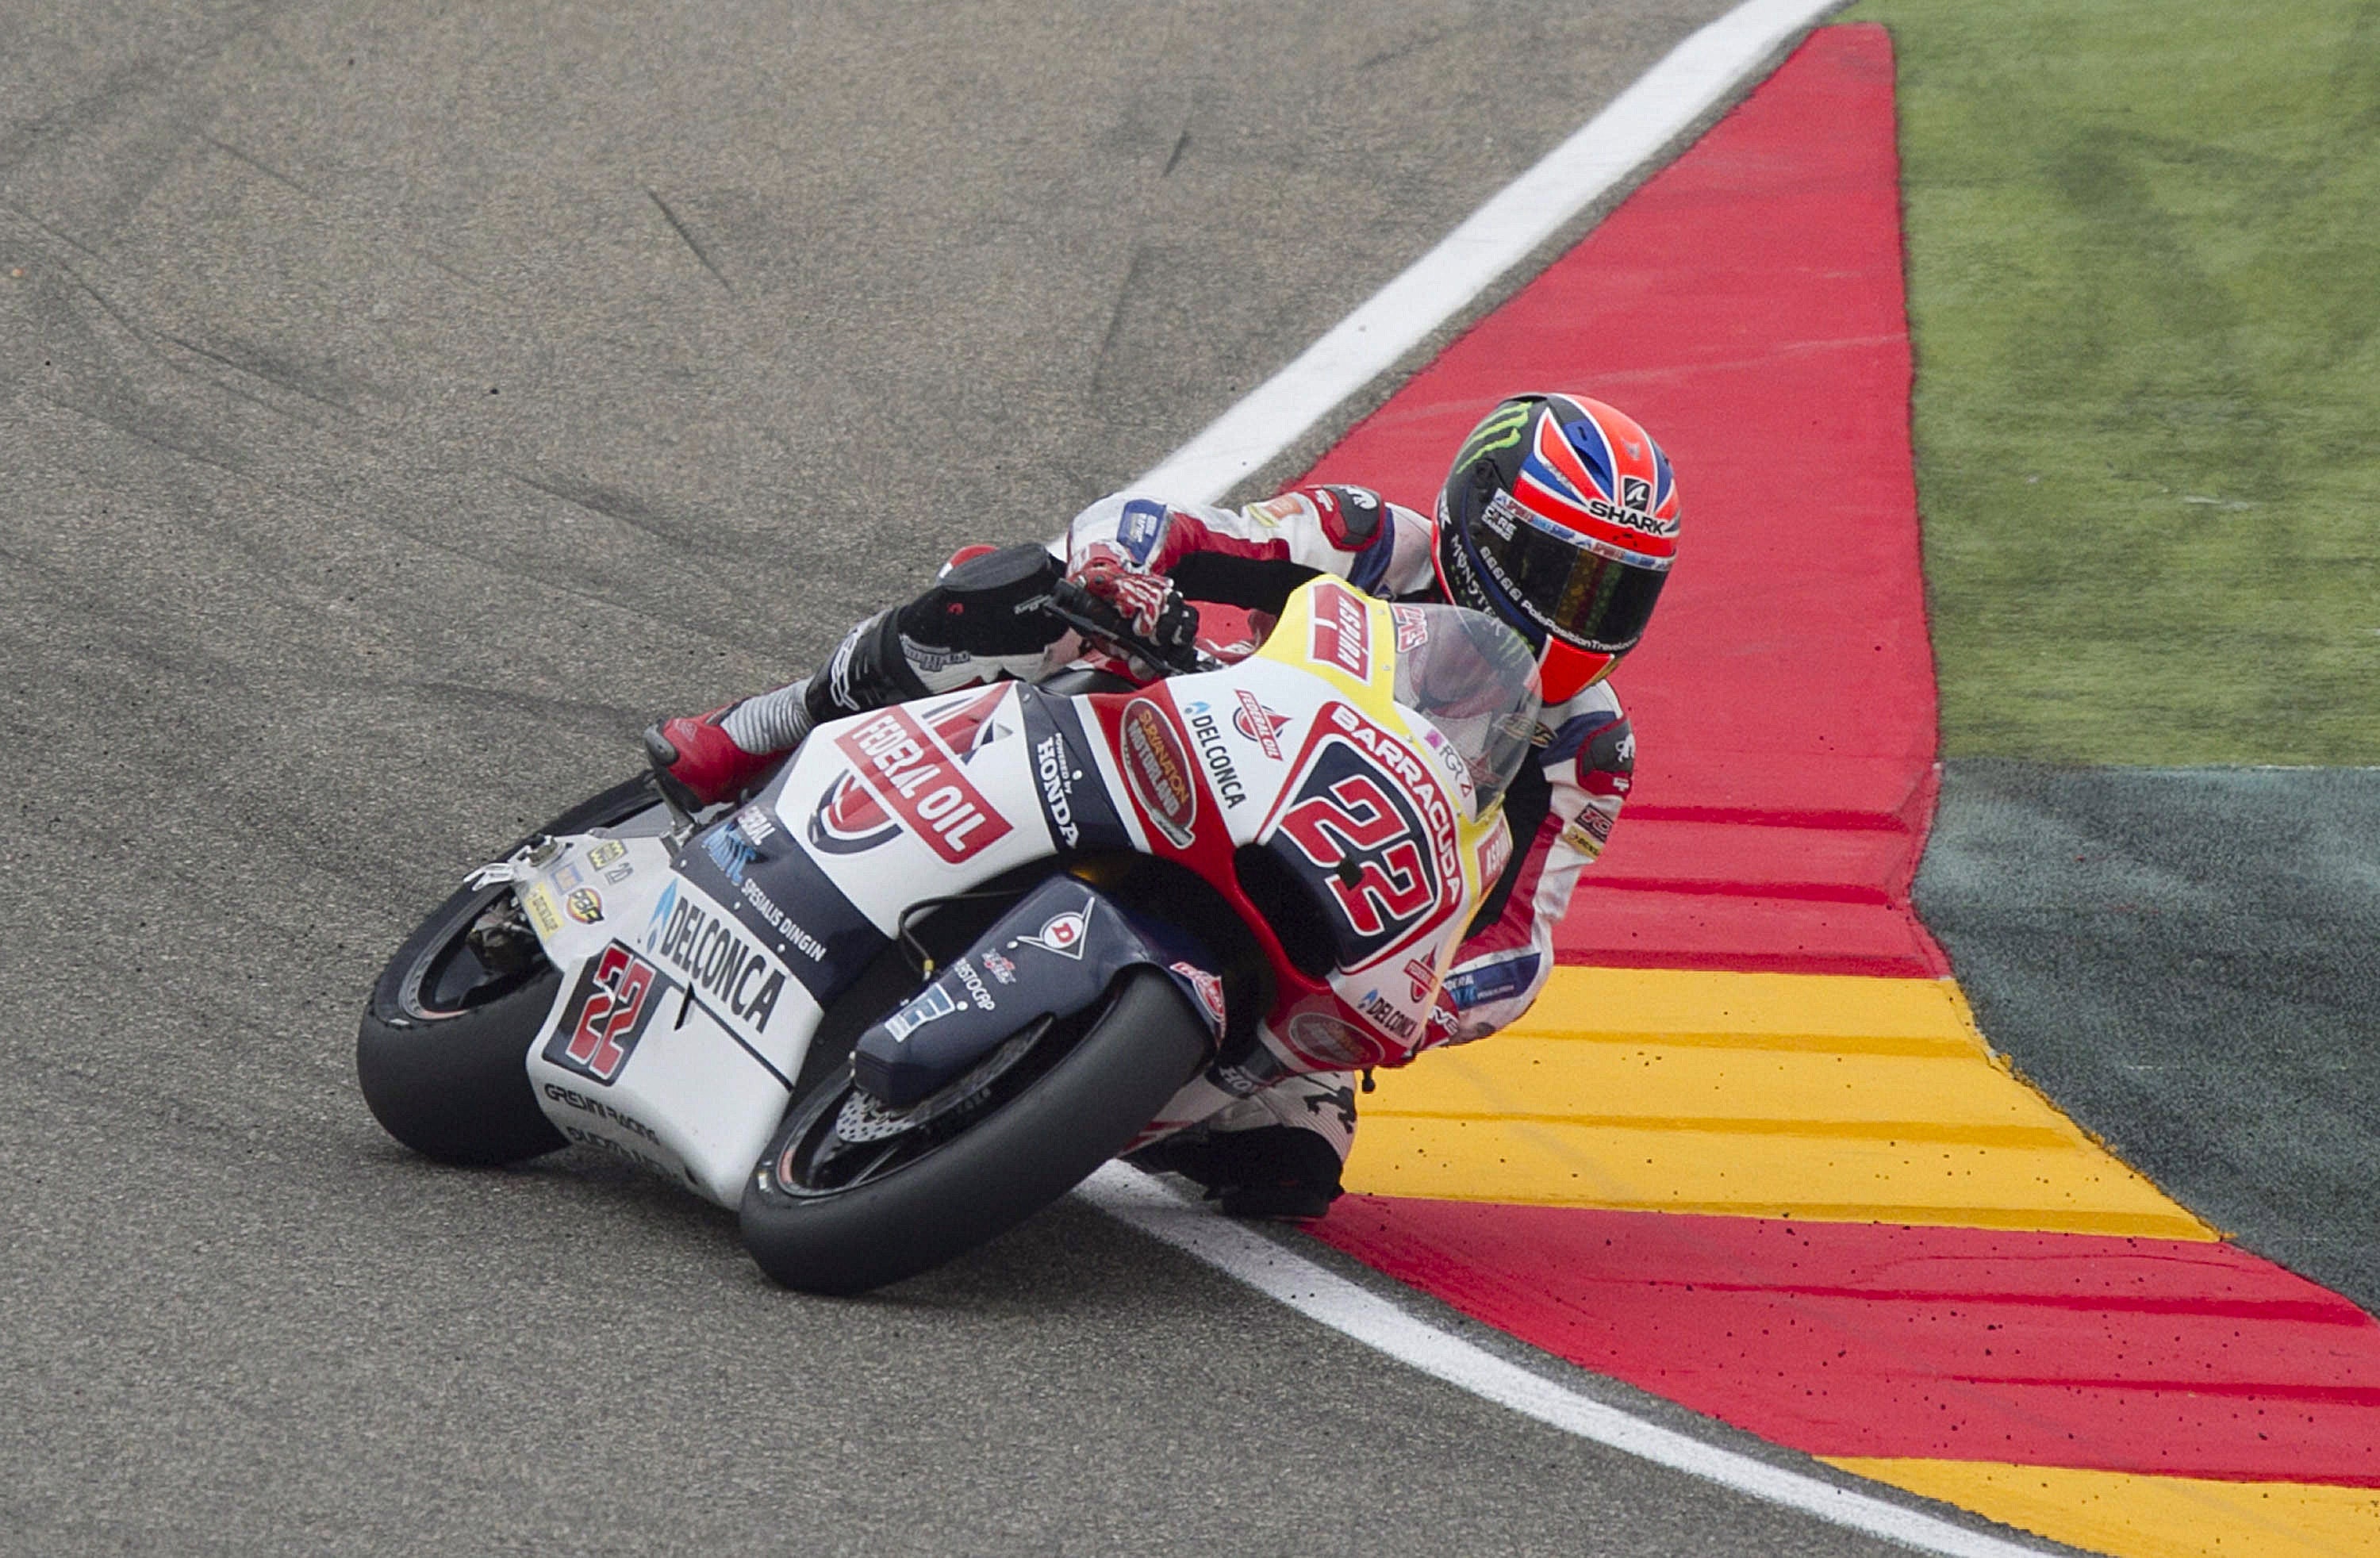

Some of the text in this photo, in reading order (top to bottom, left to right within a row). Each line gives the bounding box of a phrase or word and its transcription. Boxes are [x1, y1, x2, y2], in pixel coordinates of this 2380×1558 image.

[1589, 501, 1665, 535] SHARK
[1338, 595, 1361, 670] ASPIRA
[1055, 732, 1073, 794] POWERED BY
[1127, 719, 1180, 816] MOTORLAND
[1191, 714, 1247, 809] DELCONCA
[1242, 693, 1280, 758] FEDERAL OIL
[852, 715, 941, 799] FEDERAL
[917, 785, 986, 852] OIL
[1037, 736, 1079, 849] HONDA
[1330, 704, 1461, 904] BARRACUDA
[1278, 774, 1434, 936] 22
[660, 896, 786, 1034] DELCONCA
[741, 877, 827, 962] SPESIALIS DINGIN
[1051, 923, 1074, 943] D
[565, 942, 657, 1080] 22
[544, 1083, 606, 1118] GRESINI
